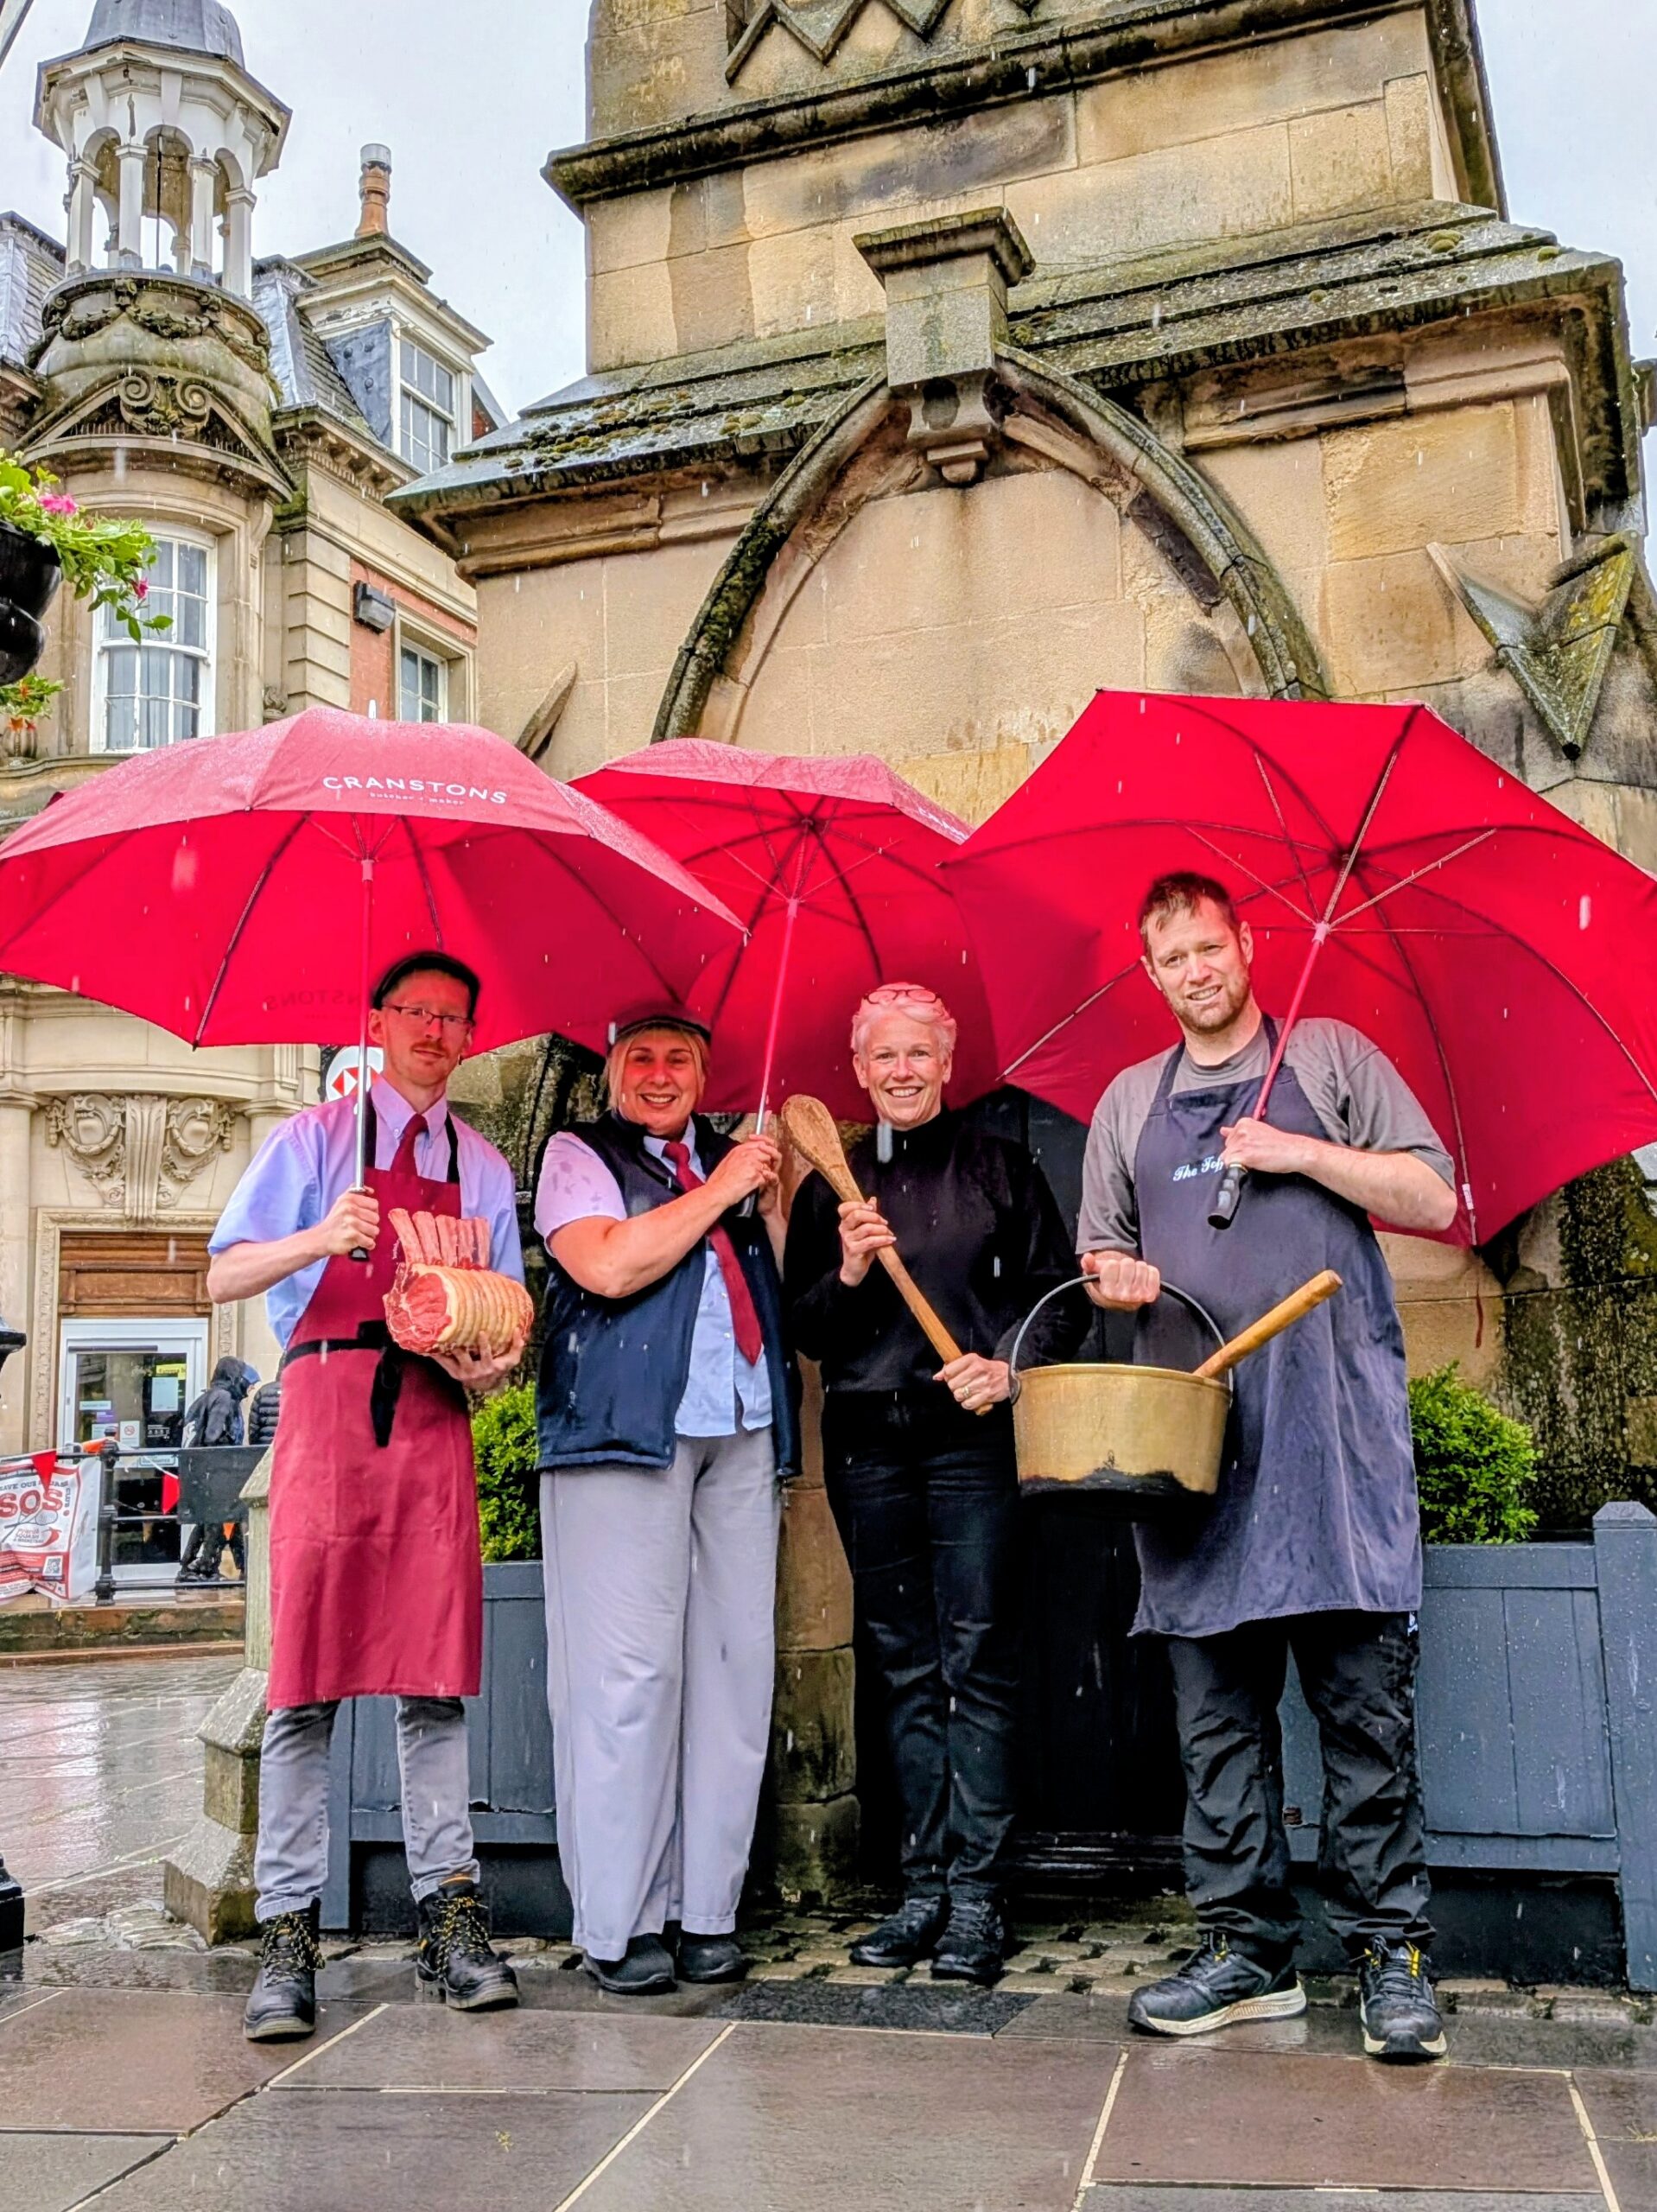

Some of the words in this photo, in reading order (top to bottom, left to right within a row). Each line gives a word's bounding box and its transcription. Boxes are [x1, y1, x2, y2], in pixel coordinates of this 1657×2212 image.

[323, 777, 507, 804] CRANSTONS
[1173, 1165, 1197, 1181] The
[0, 1490, 63, 1517] SOS
